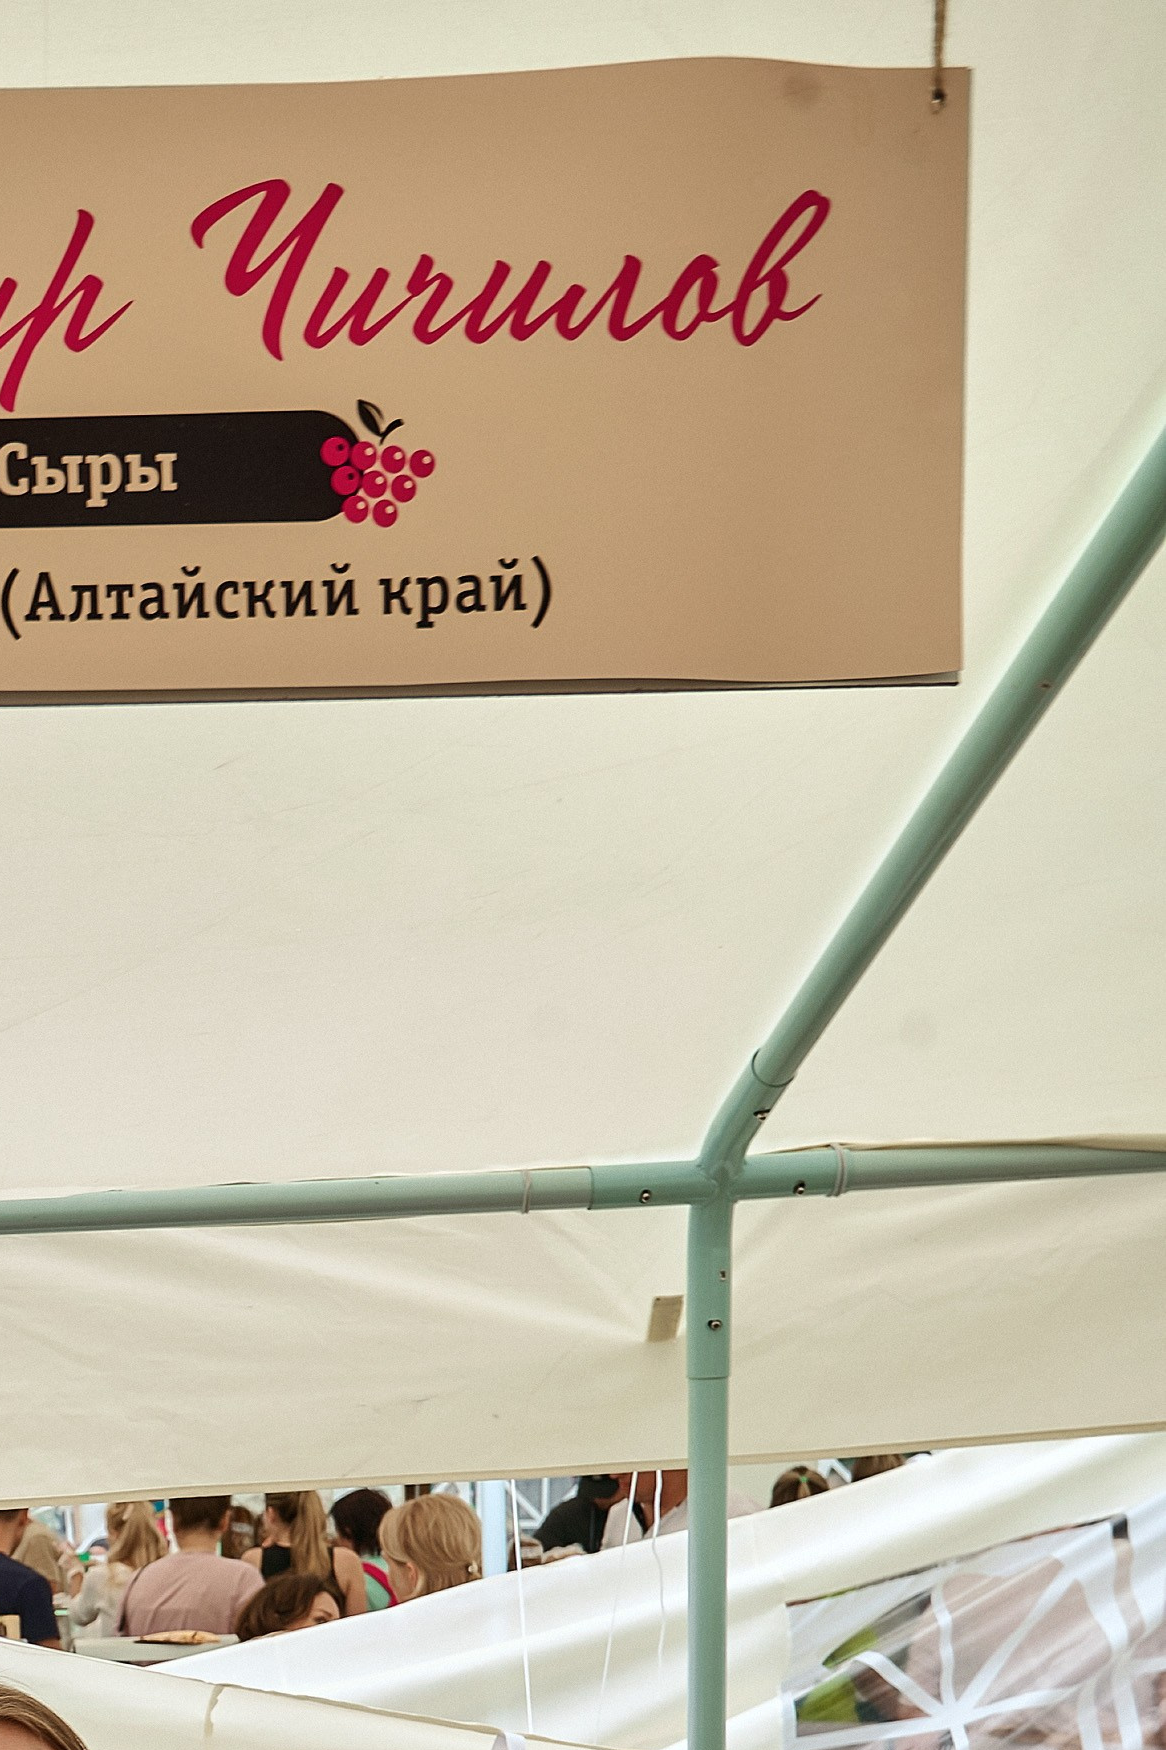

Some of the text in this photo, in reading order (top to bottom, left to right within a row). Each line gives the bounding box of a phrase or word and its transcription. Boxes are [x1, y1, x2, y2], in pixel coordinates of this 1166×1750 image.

[190, 178, 831, 362] Чичилов
[0, 562, 359, 640] (Алтайский
[381, 555, 554, 631] край)
